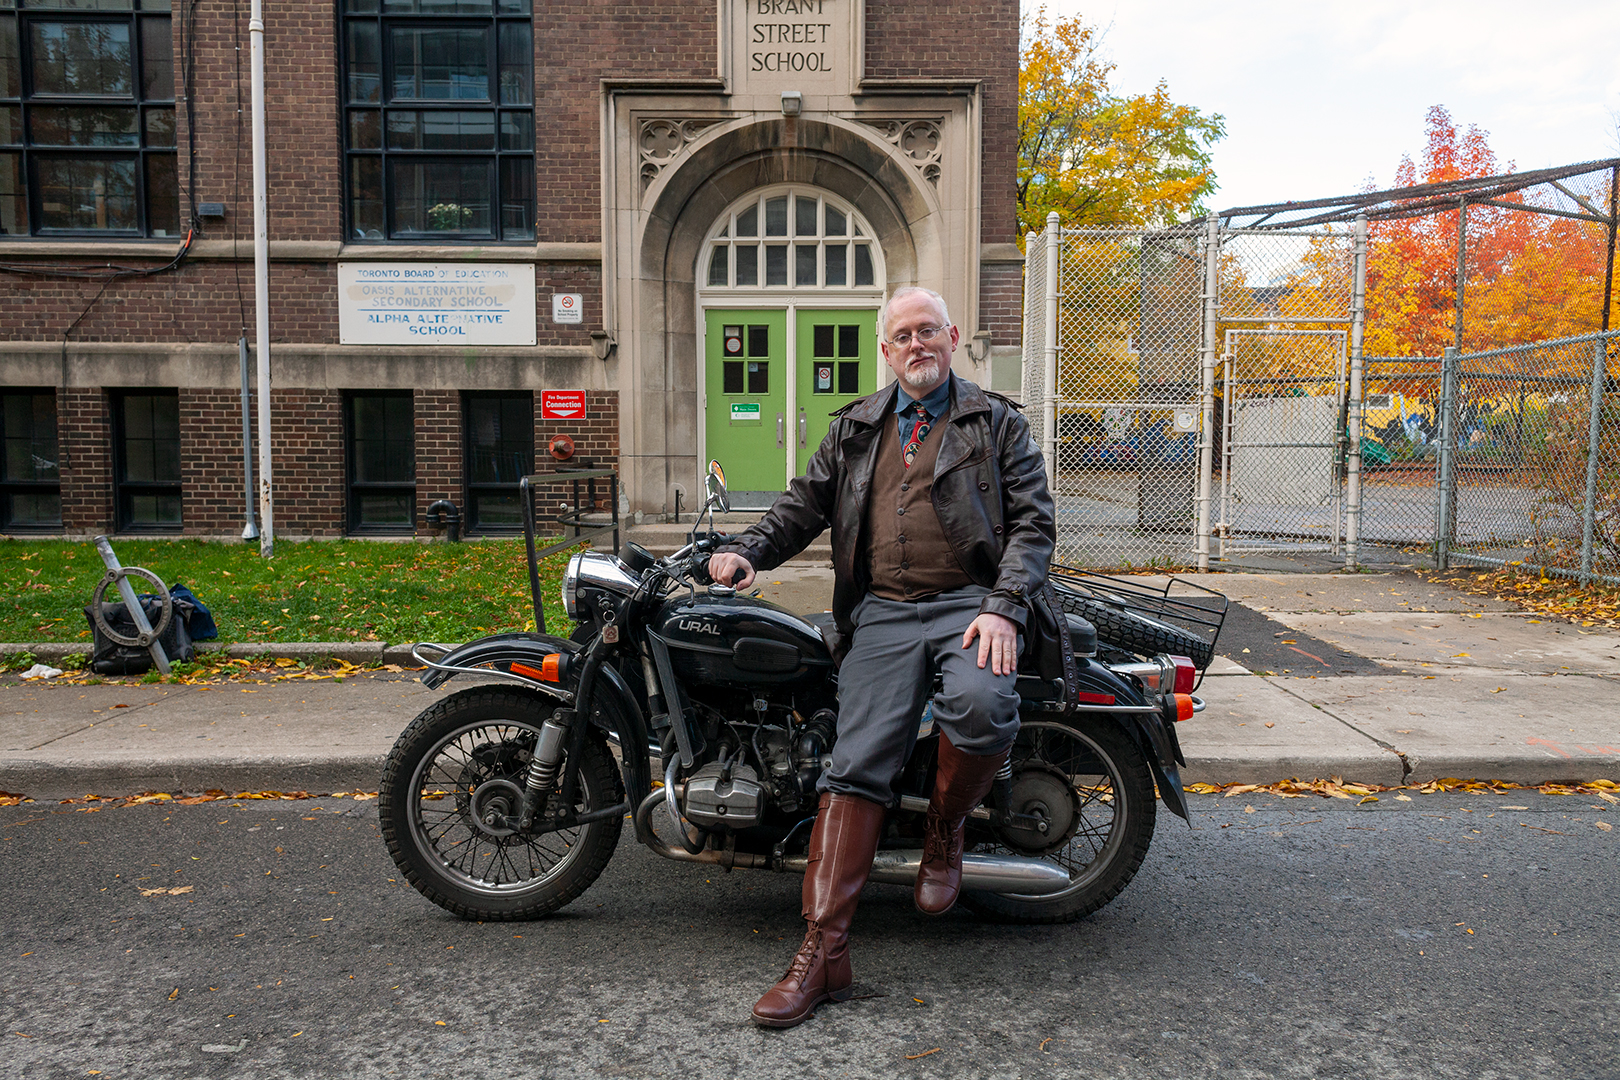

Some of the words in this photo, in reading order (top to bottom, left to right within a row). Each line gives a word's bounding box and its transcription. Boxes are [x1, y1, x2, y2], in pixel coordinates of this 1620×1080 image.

[757, 0, 823, 15] BRANT
[752, 23, 831, 43] STREET
[751, 52, 832, 72] SCHOOL
[357, 269, 400, 278] TORONTO
[404, 269, 435, 278] BOARD
[438, 269, 449, 278] OF
[455, 269, 509, 278] EDUCATON
[362, 285, 395, 296] OASIS
[404, 285, 486, 296] ALTERNATIVE
[372, 296, 443, 308] SECONDARY
[450, 295, 503, 308] SCHOOL
[367, 314, 410, 324] ALPHA
[409, 325, 466, 336] SCHOOL
[678, 619, 721, 636] URAL
